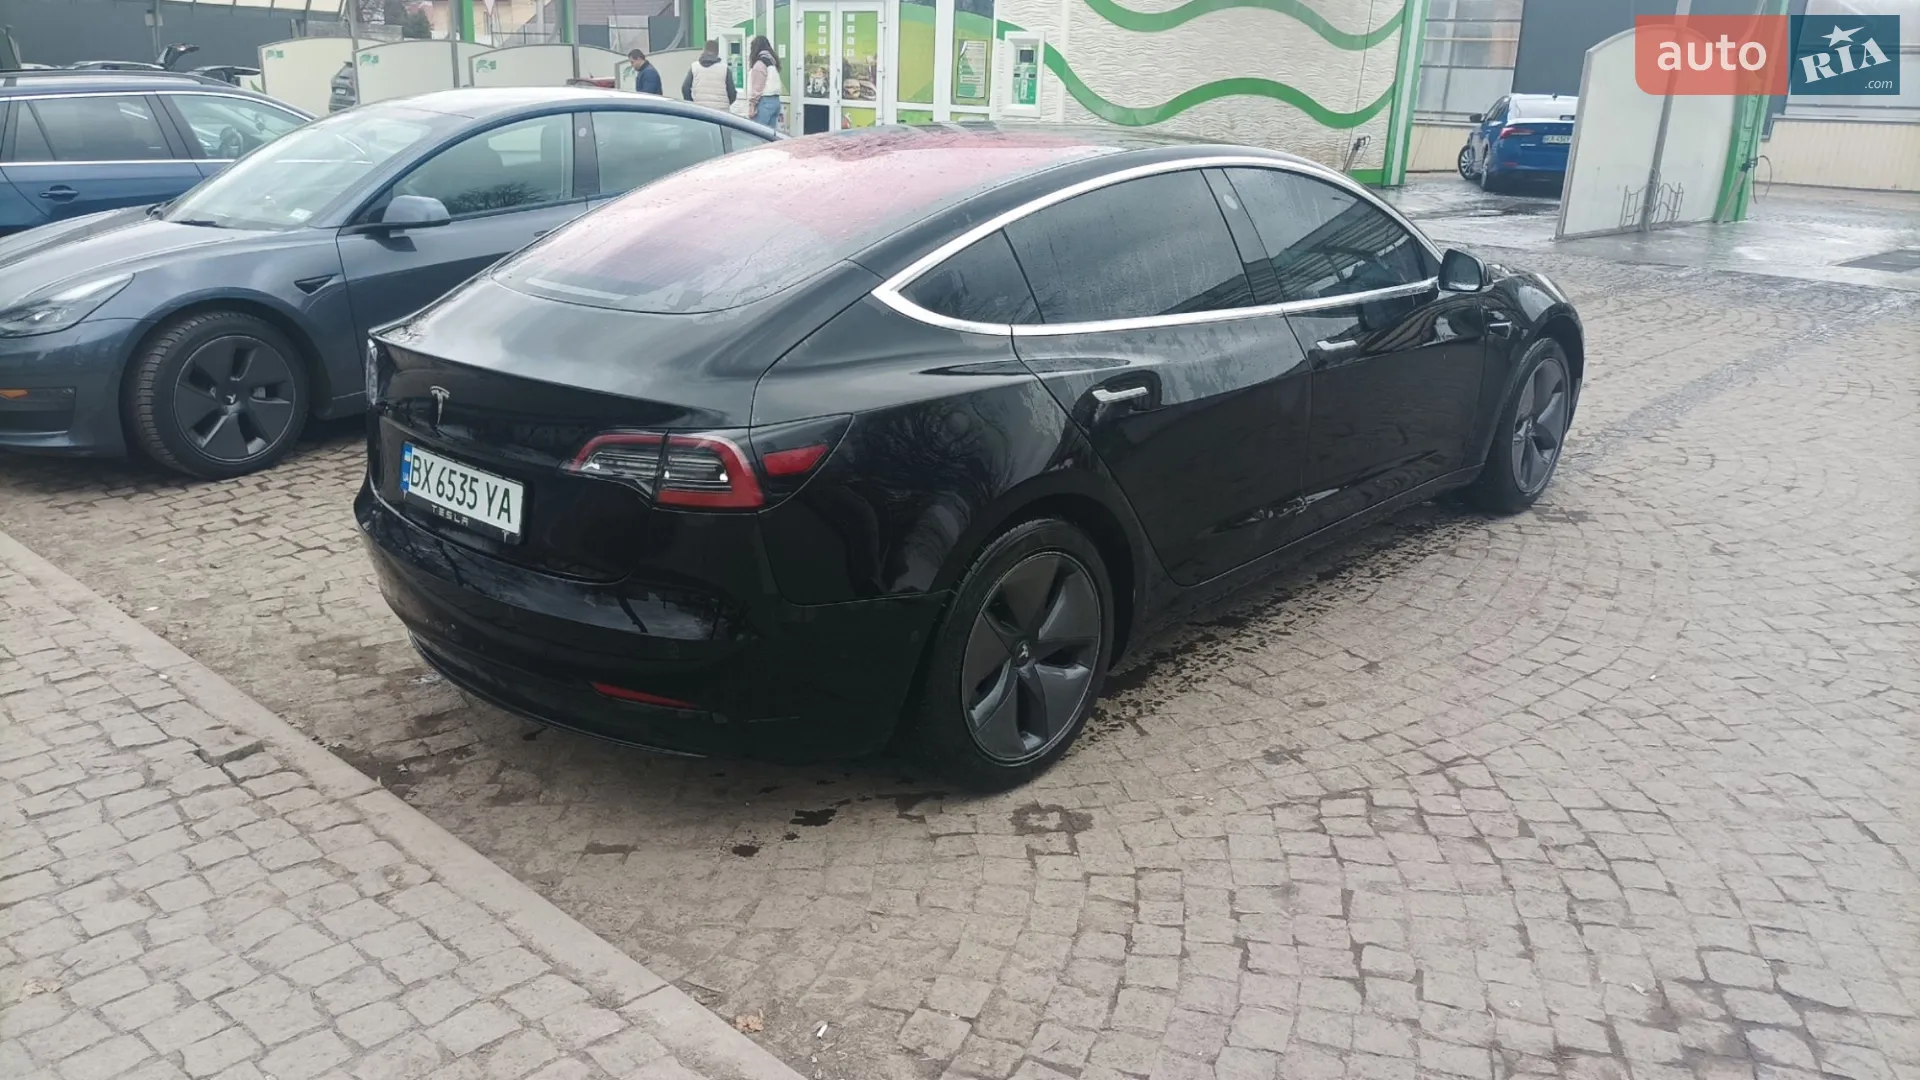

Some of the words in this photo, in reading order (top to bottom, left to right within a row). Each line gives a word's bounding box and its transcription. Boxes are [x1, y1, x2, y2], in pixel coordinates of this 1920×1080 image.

[410, 454, 434, 494] BX
[436, 466, 479, 510] 6535
[486, 481, 511, 524] YA
[431, 504, 469, 527] TESLA
